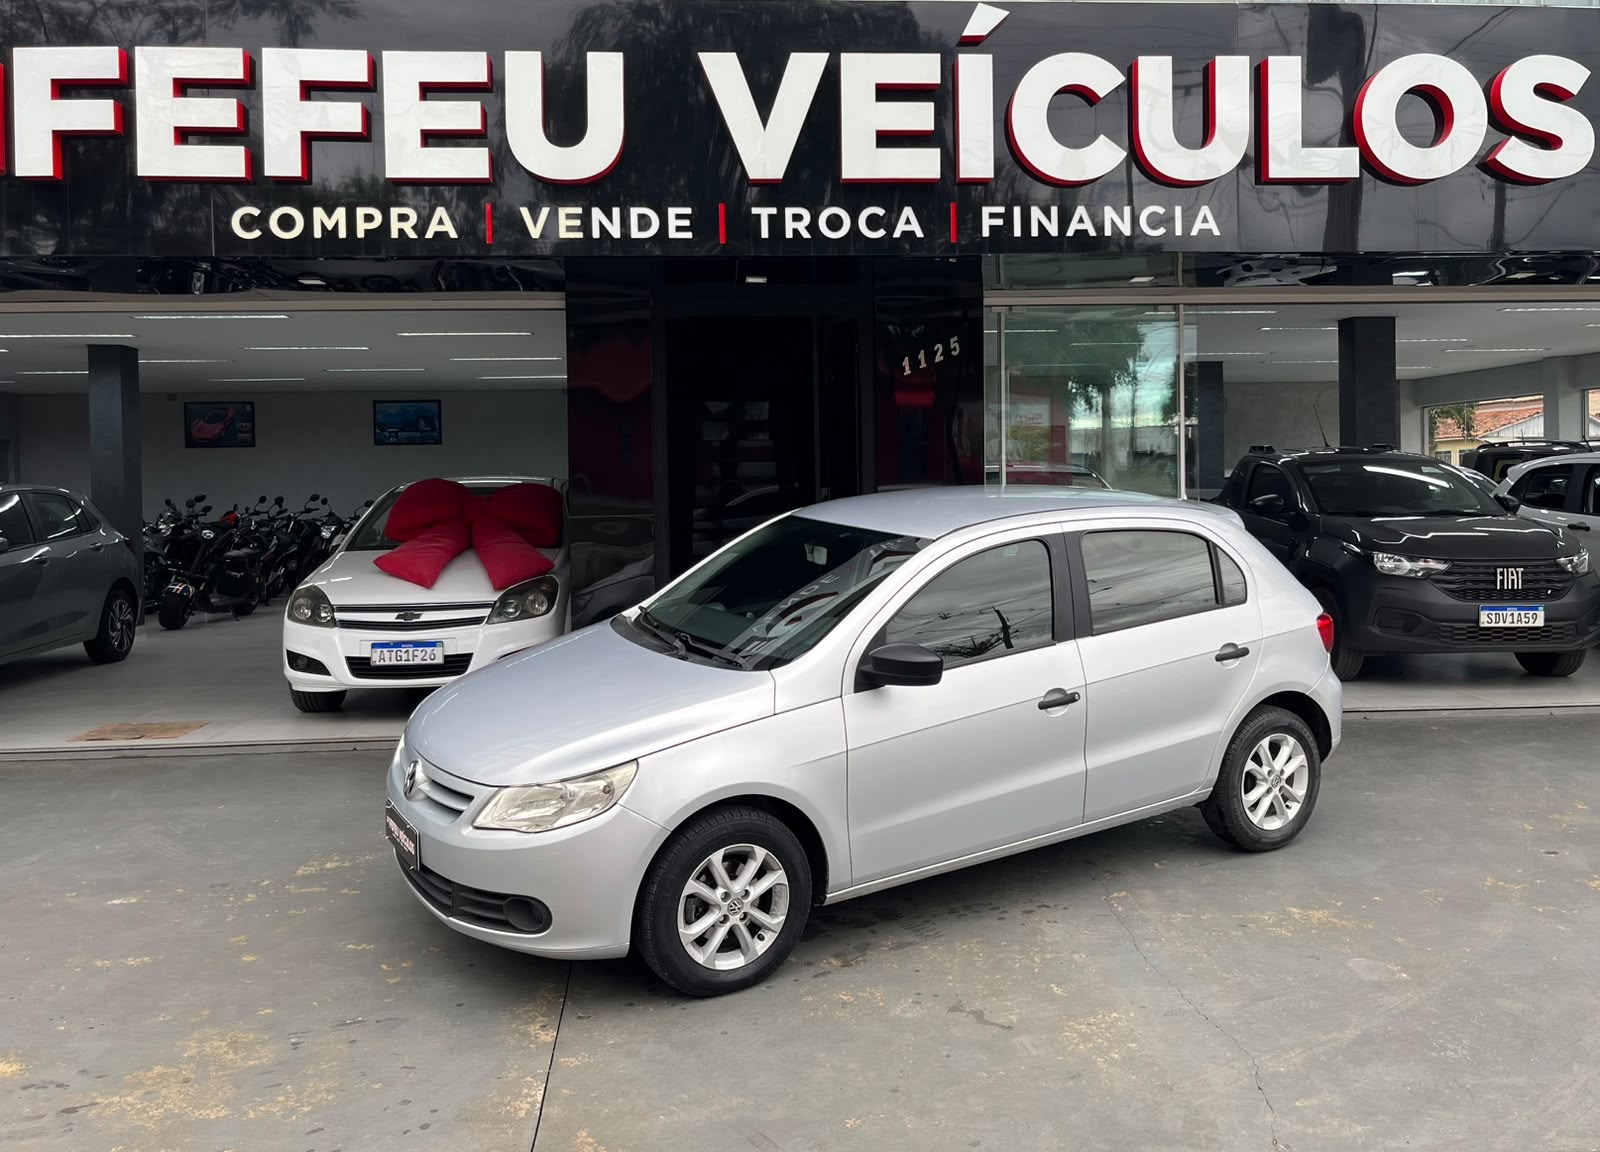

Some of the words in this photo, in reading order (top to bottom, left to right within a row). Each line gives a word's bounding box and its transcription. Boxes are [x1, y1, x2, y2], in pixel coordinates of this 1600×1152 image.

[12, 46, 625, 184] FEFEU
[698, 2, 1597, 187] VEÍCULOS
[230, 206, 459, 241] COMPRA
[519, 206, 694, 241] VENDE
[751, 206, 924, 240] TROCA
[980, 205, 1221, 238] FINANCIA
[1496, 567, 1524, 590] FIAT
[1486, 612, 1538, 624] SDV1A59
[378, 648, 436, 663] ATG1F26
